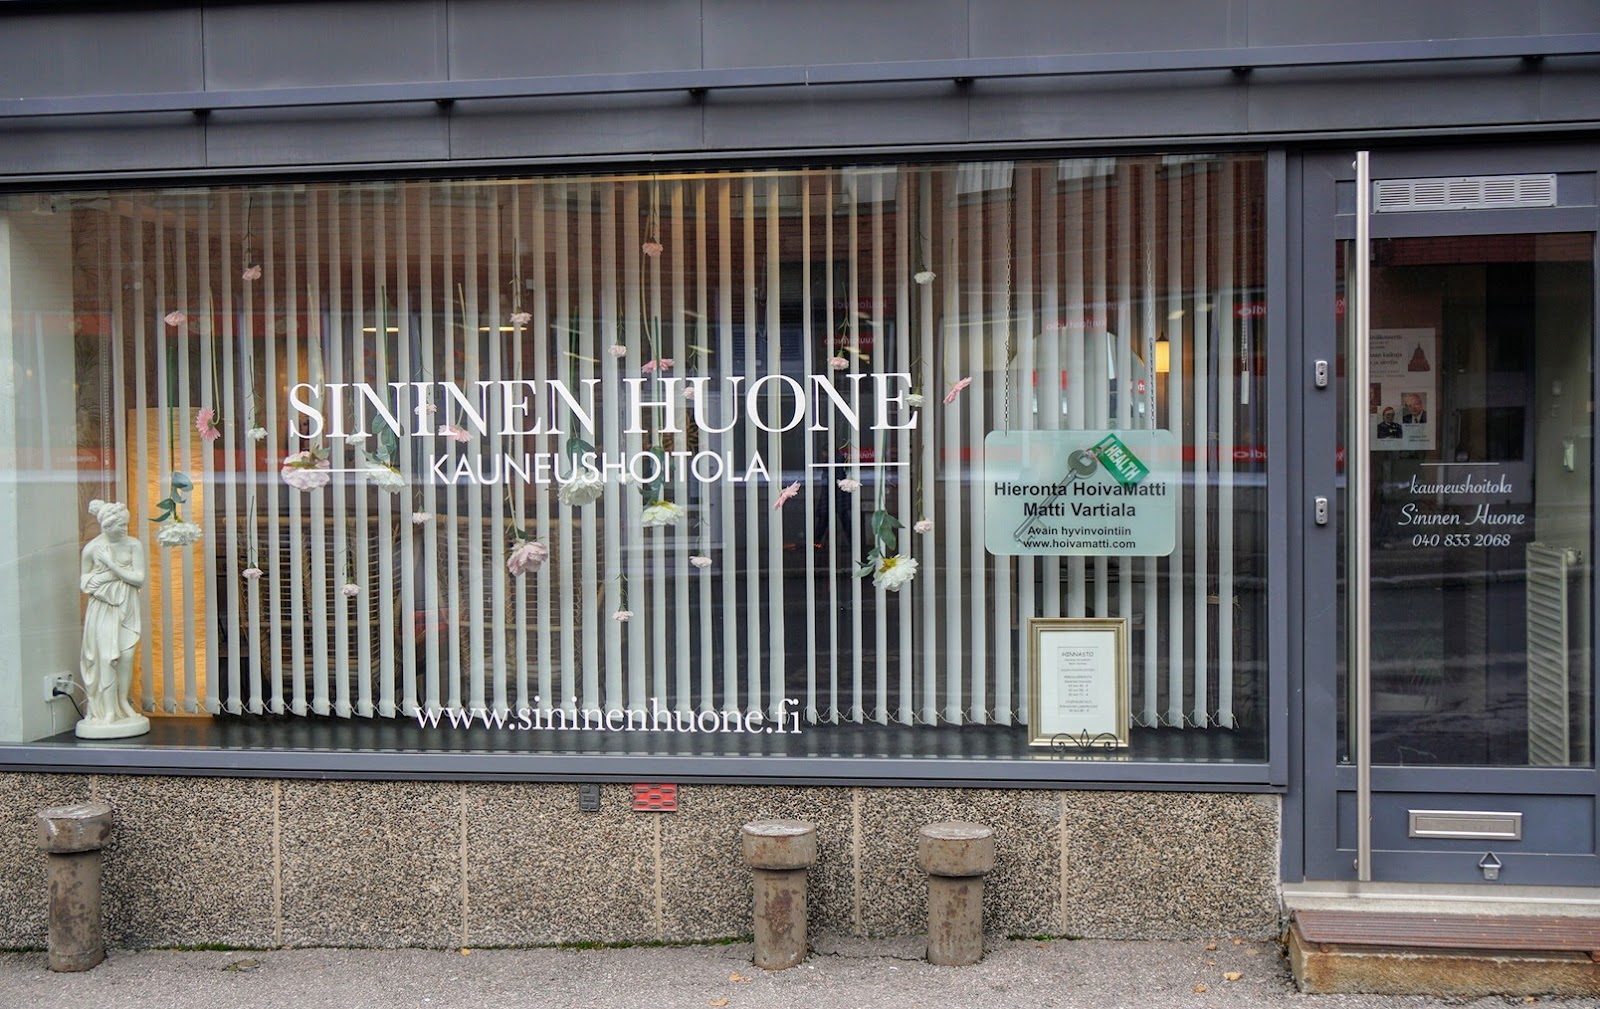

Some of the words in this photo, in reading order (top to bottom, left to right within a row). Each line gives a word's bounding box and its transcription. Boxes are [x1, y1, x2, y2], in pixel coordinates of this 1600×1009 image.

[289, 378, 602, 439] SININEN
[622, 372, 918, 434] HUONE
[430, 449, 771, 486] KAUNEUSHOITOLA
[1104, 443, 1141, 481] HEALTH
[994, 481, 1067, 496] Hieronta
[1073, 481, 1166, 496] HoivaMatti
[1410, 473, 1512, 494] kauneushoitola
[1023, 502, 1065, 517] Matti
[1071, 502, 1136, 517] Vartiala
[1398, 503, 1460, 526] Sininen
[1465, 503, 1525, 526] Huone
[1028, 526, 1058, 536] Avain
[1061, 526, 1131, 539] hyvinvointiin
[1412, 533, 1440, 547] 040
[1444, 533, 1470, 547] 833
[1474, 533, 1511, 547] 2068
[1023, 539, 1136, 549] www.hoivamatti.com
[412, 695, 803, 734] www.sininenhuone.fi
